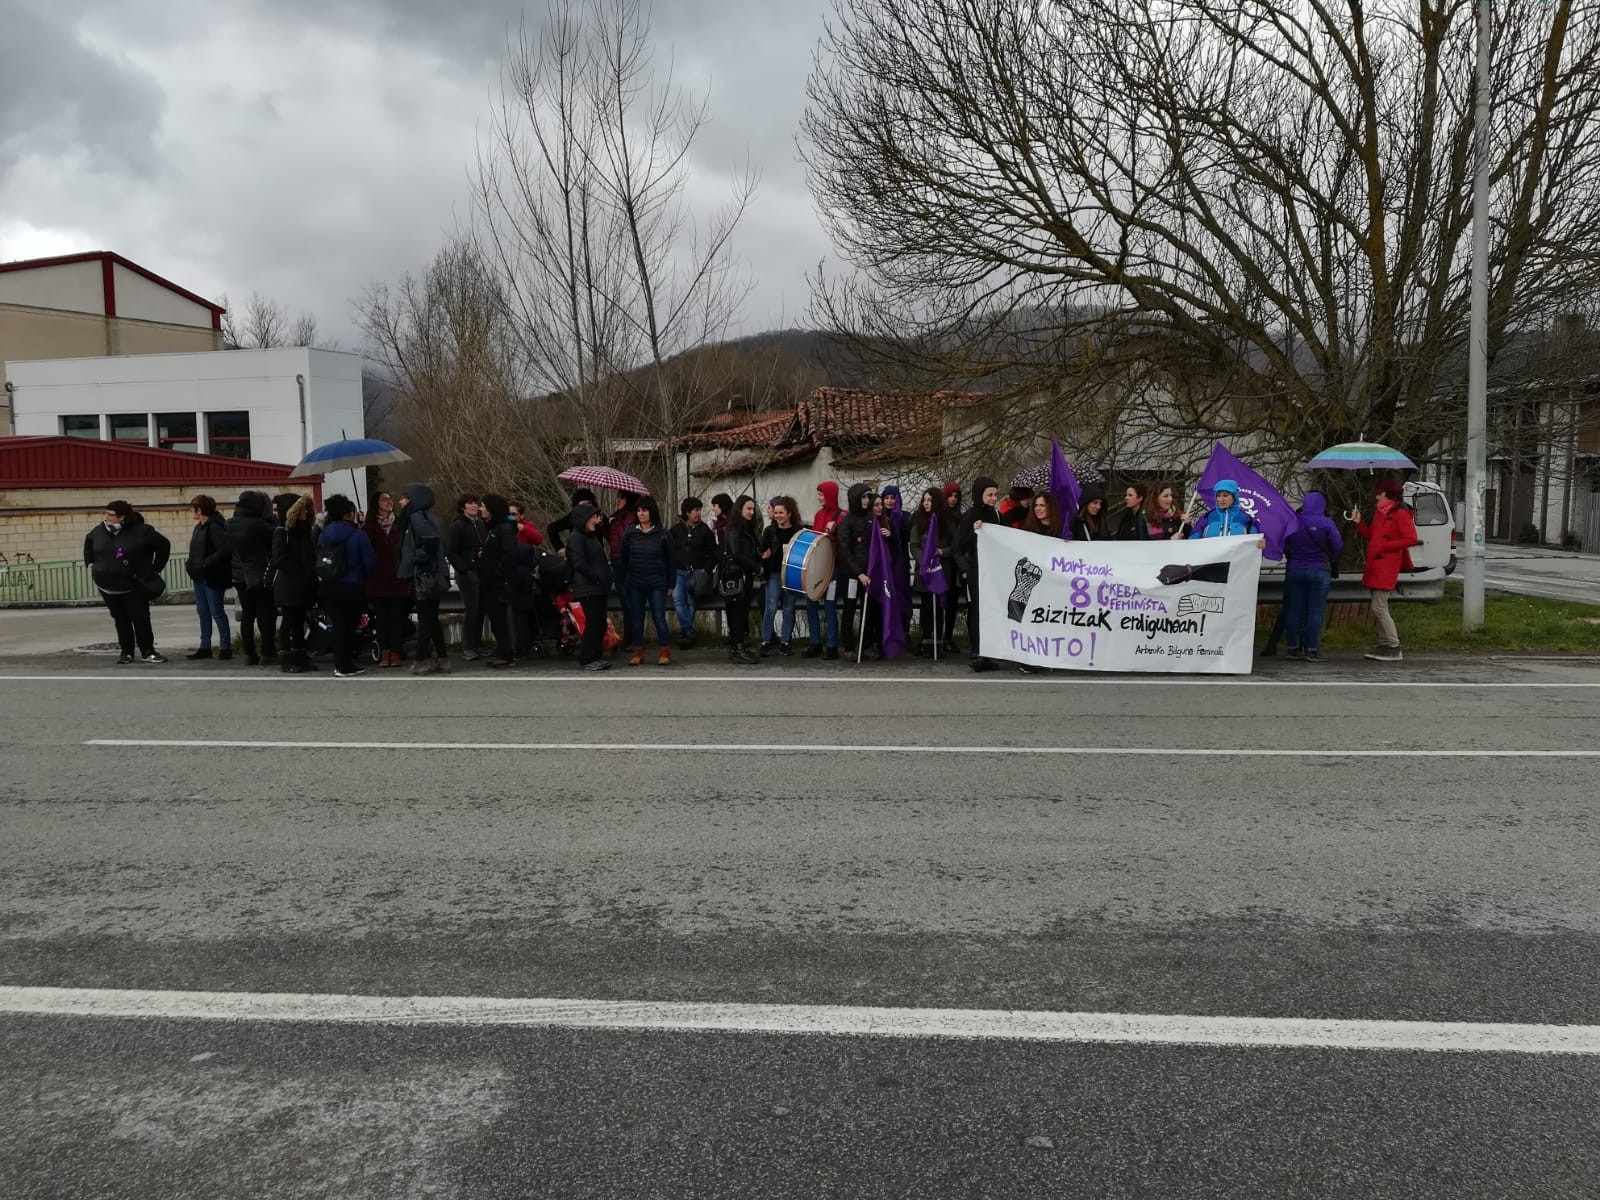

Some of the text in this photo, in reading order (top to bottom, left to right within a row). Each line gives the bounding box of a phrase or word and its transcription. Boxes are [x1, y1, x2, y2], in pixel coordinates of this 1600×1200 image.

[1051, 557, 1113, 576] Martxoak
[1070, 577, 1091, 609] 8
[1010, 629, 1096, 667] PLANTO!
